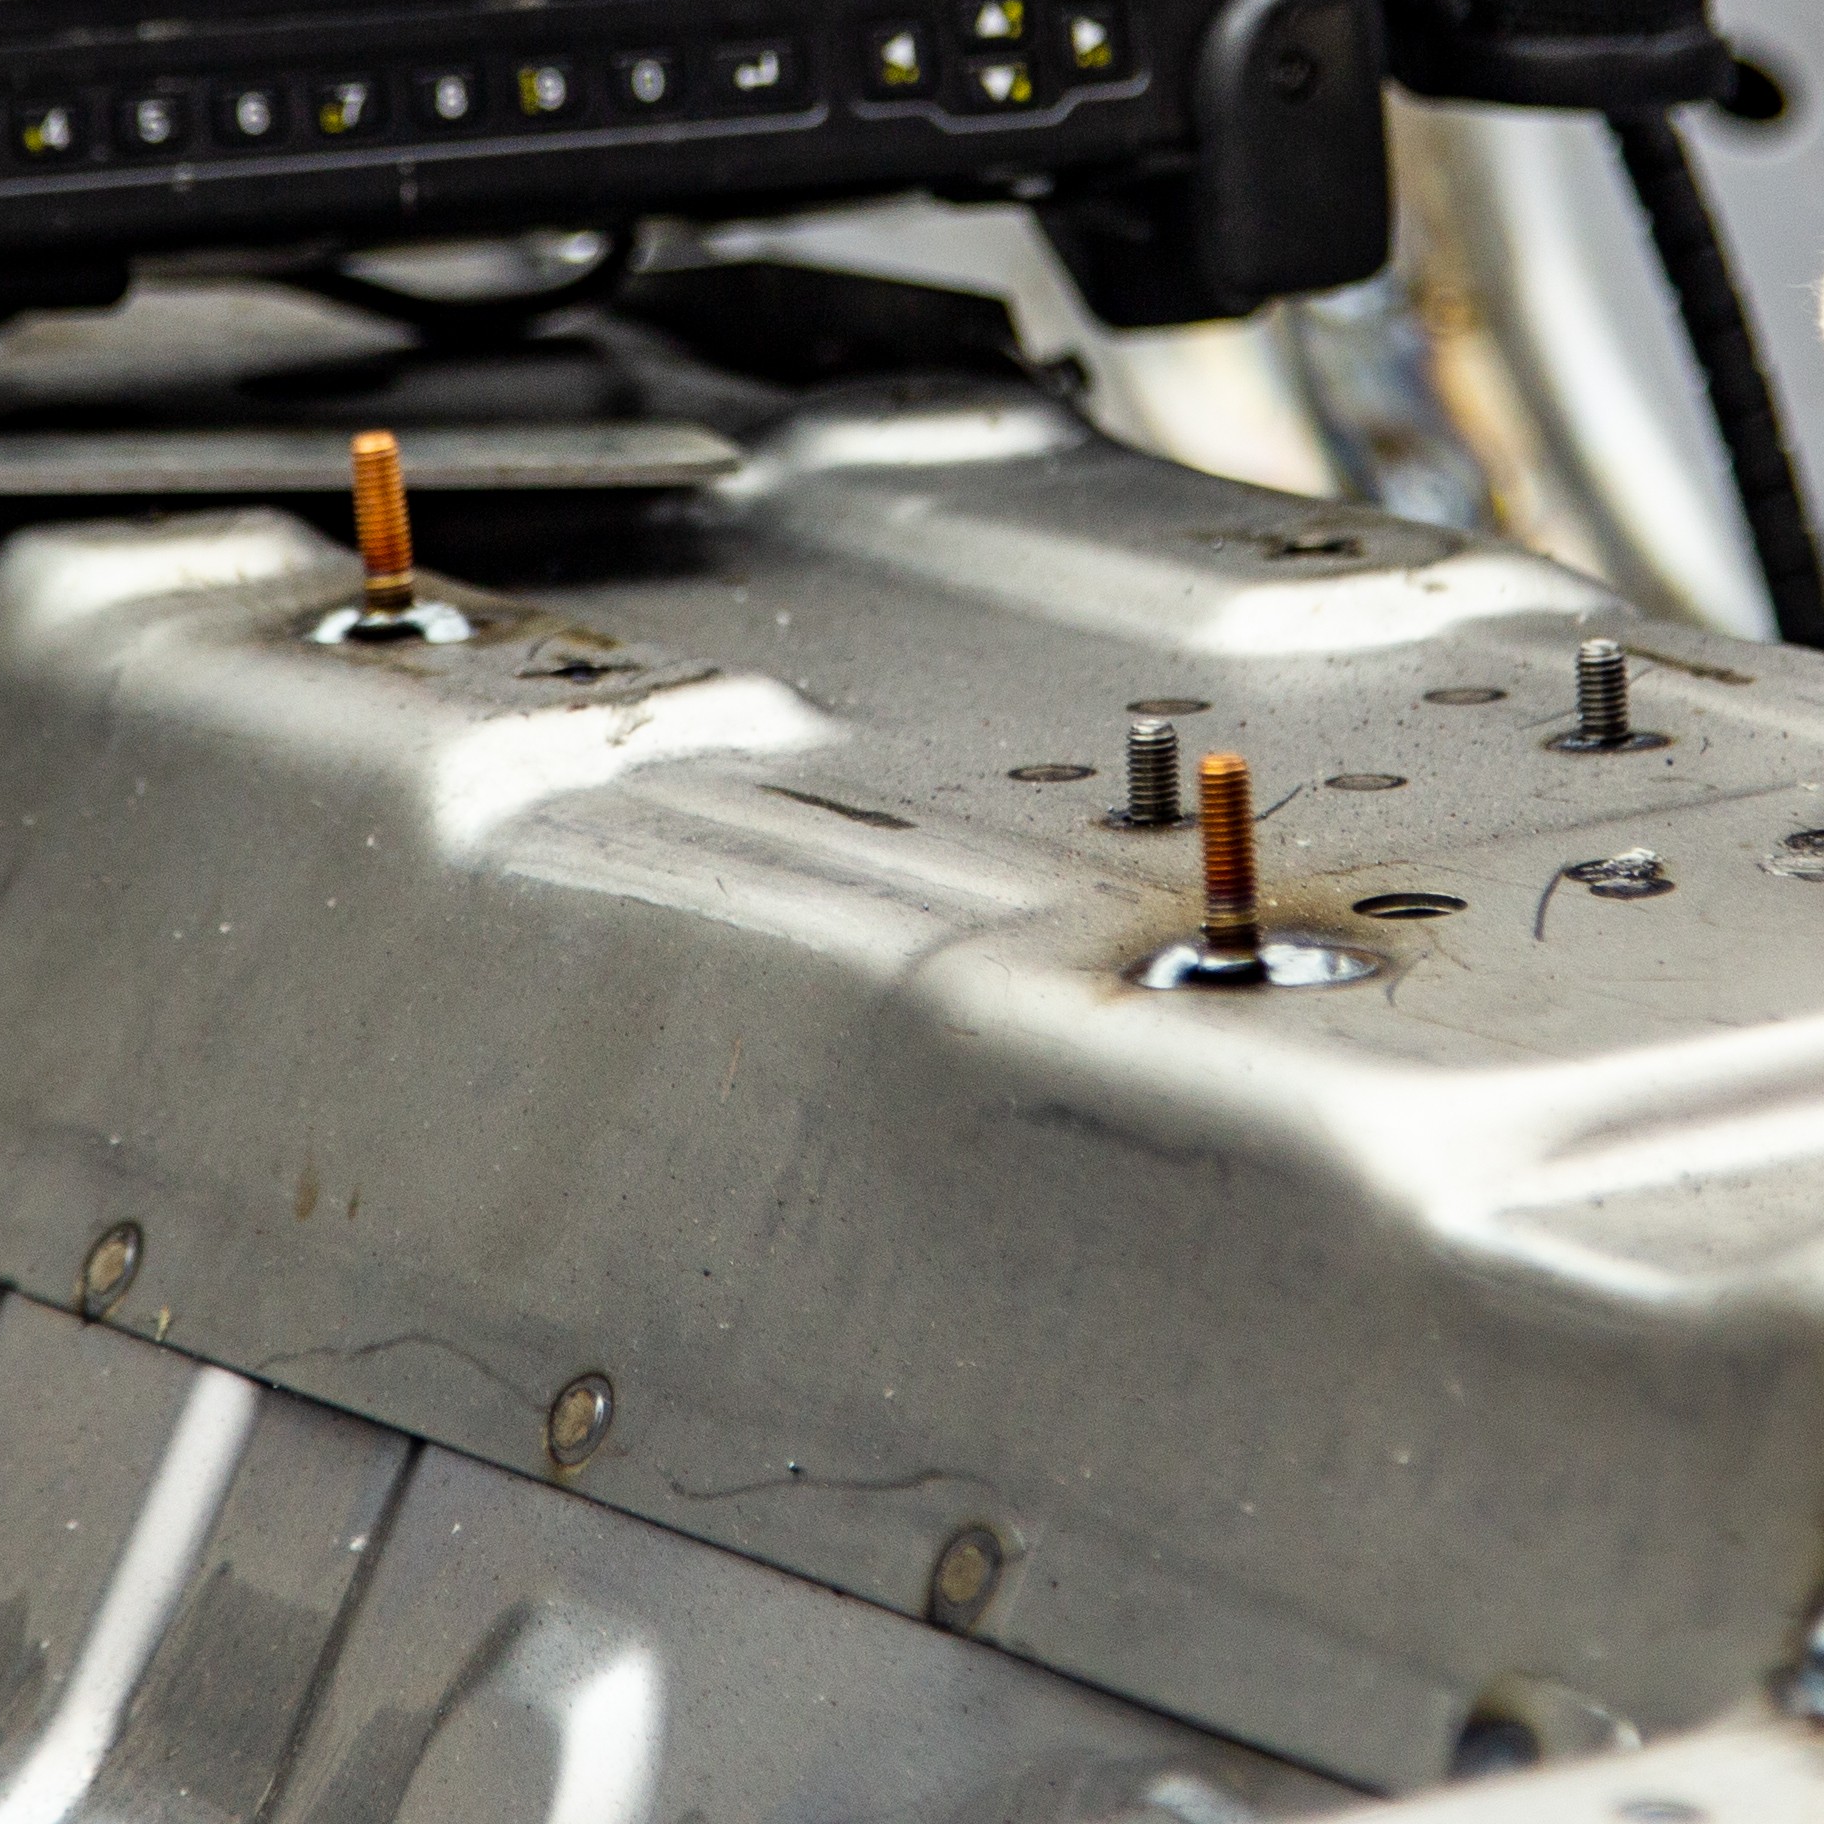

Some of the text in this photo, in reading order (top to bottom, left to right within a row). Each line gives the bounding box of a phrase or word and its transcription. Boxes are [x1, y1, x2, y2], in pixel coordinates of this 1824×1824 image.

[39, 106, 71, 151] 4
[137, 98, 172, 144] 5
[236, 90, 272, 136] 6
[338, 82, 367, 128] 7
